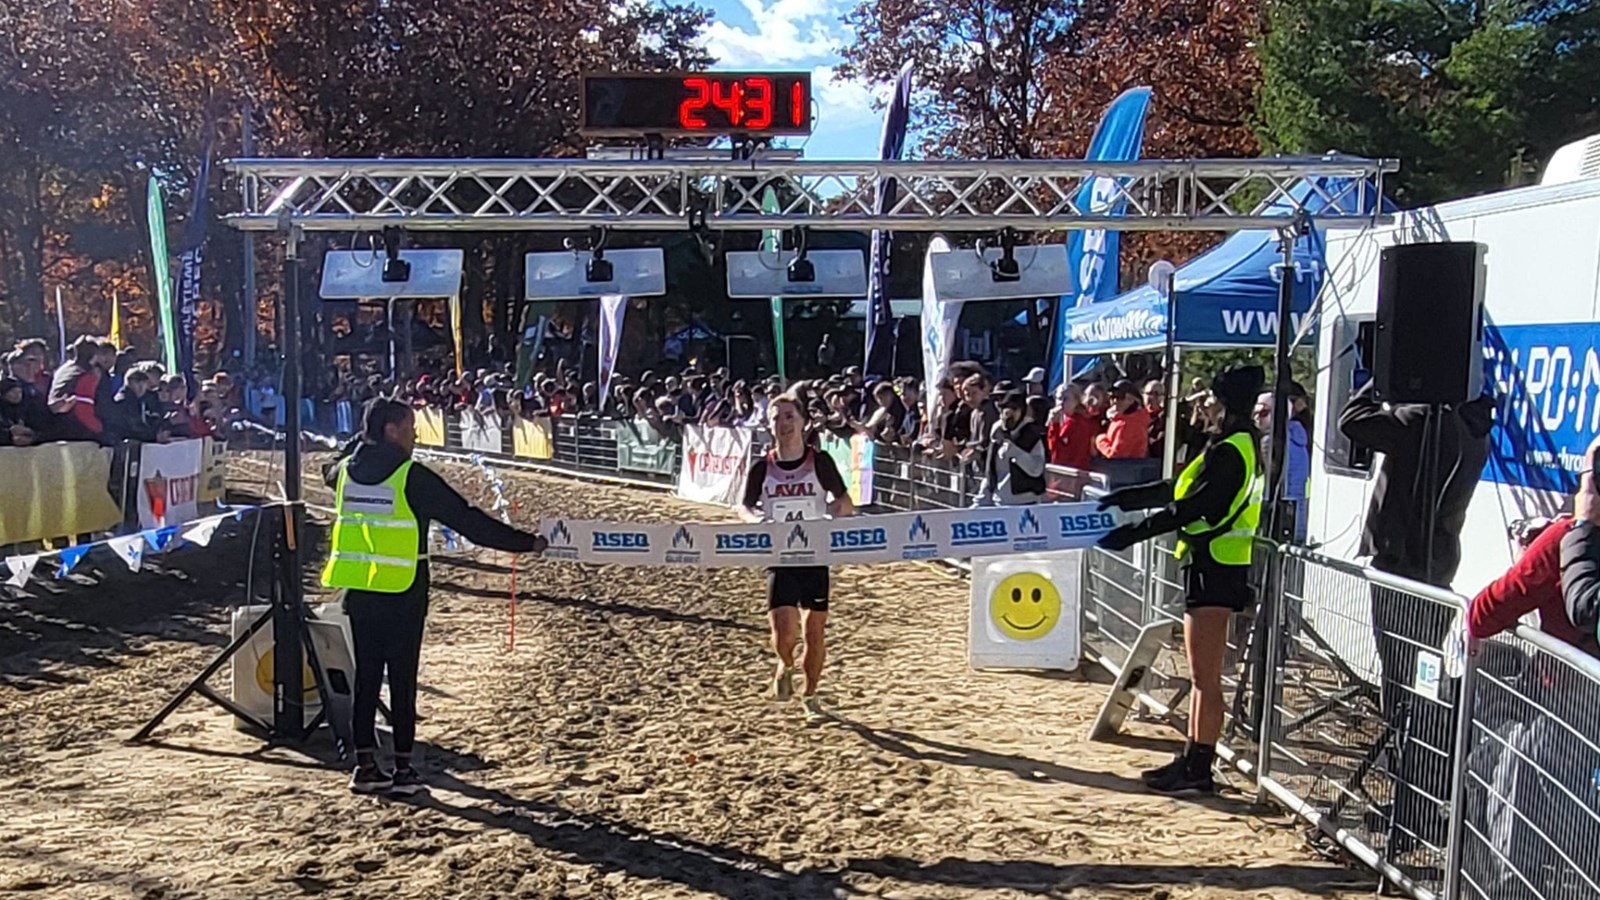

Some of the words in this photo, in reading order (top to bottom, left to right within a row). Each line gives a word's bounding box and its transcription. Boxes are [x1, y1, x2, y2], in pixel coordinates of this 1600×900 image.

[679, 78, 803, 129] 24:31
[764, 483, 816, 498] LAVAL
[951, 520, 1008, 540] RSEQ
[1060, 513, 1117, 532] RSEQ
[592, 531, 650, 547] RSEQ
[715, 533, 772, 549] RSEQ
[830, 528, 887, 548] RSEQ
